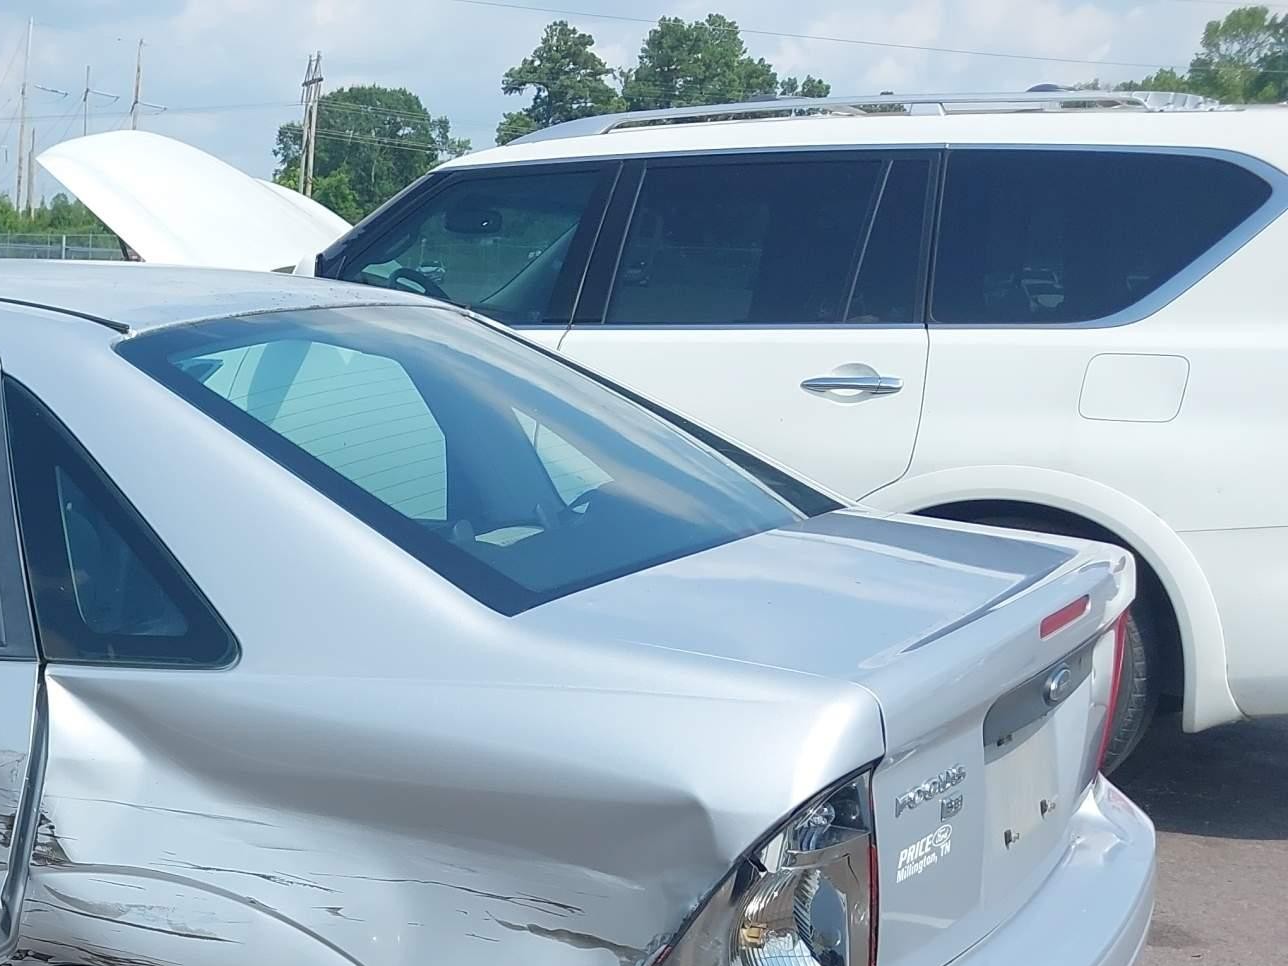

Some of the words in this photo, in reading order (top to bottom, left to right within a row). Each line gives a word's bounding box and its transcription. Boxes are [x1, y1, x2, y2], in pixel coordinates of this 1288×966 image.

[896, 852, 938, 884] Millington,
[940, 840, 951, 857] TN
[898, 833, 933, 869] PRICE
